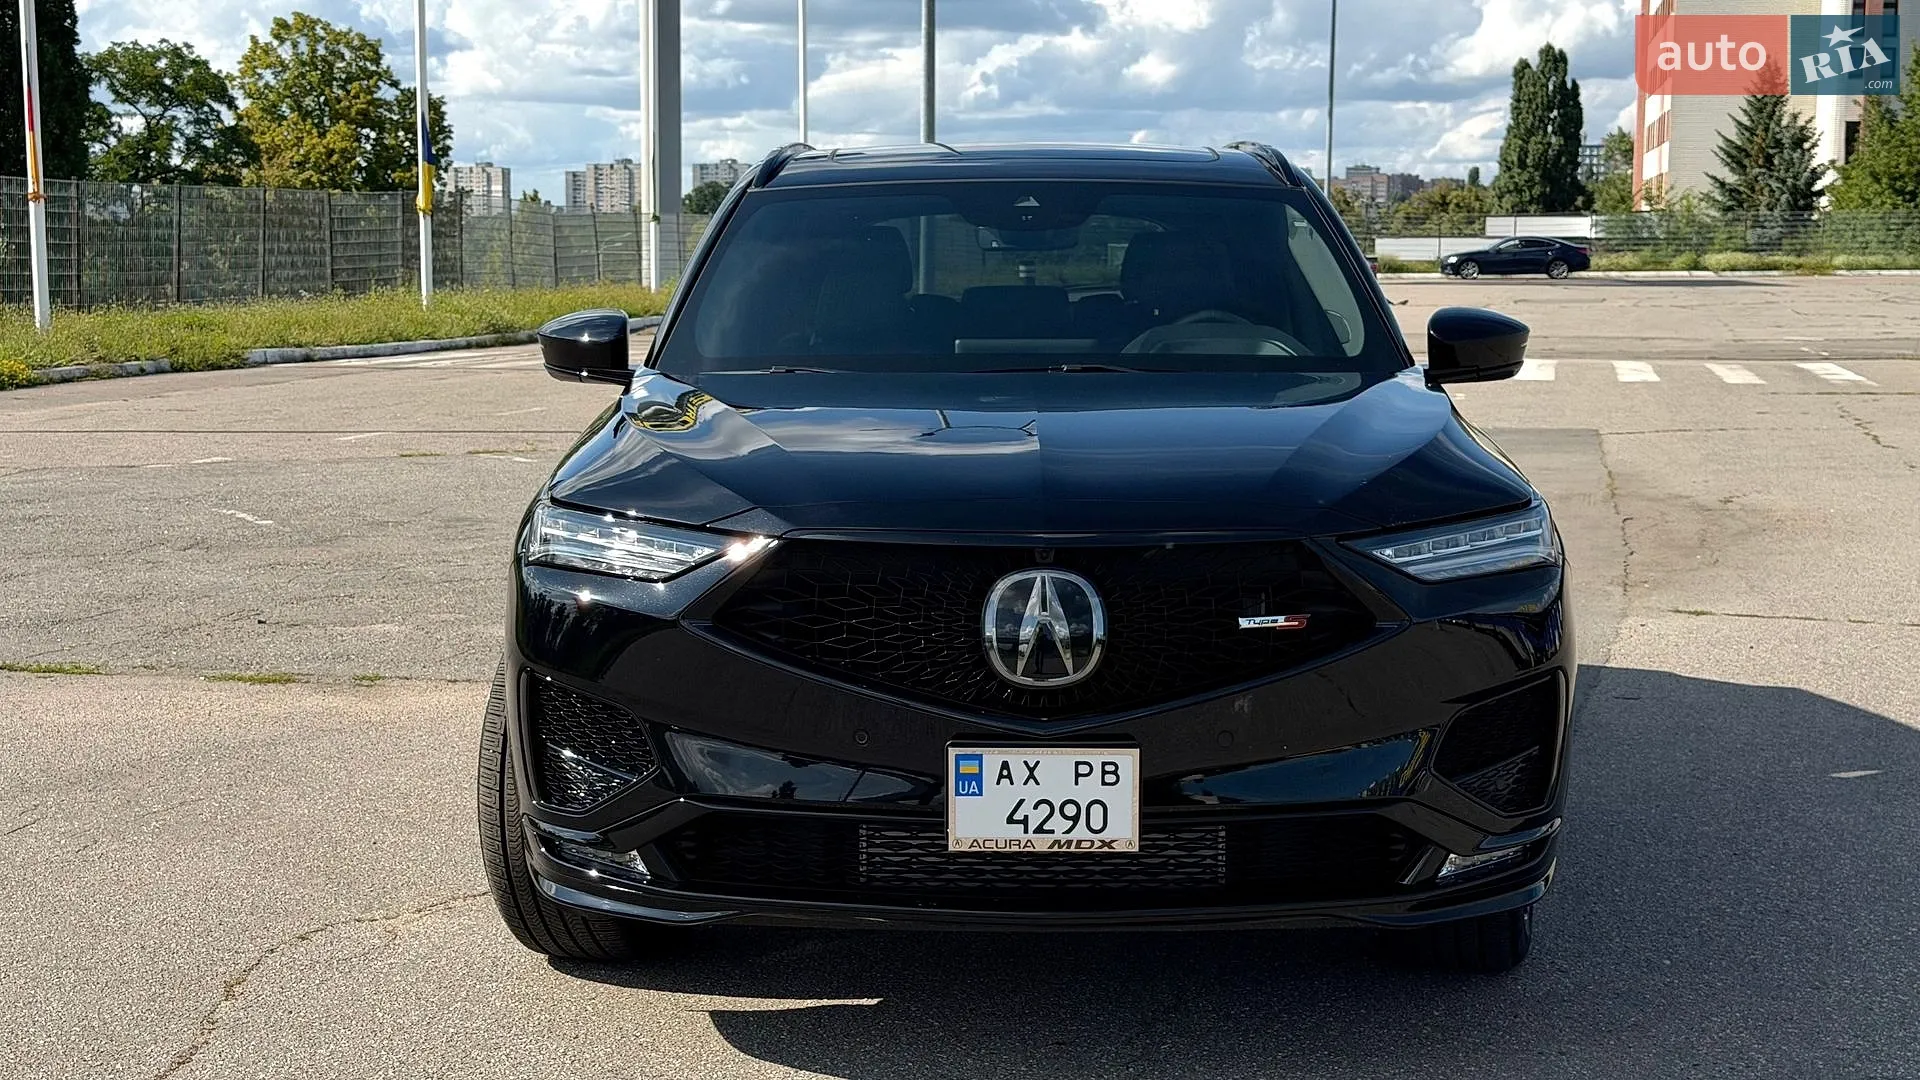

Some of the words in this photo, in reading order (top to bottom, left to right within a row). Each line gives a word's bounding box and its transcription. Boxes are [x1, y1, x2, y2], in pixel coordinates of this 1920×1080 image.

[995, 760, 1041, 786] AX
[1074, 760, 1121, 787] PB
[959, 780, 980, 795] UA
[1005, 798, 1109, 835] 4290
[968, 839, 1036, 850] ACURA
[1047, 839, 1119, 850] MDX
